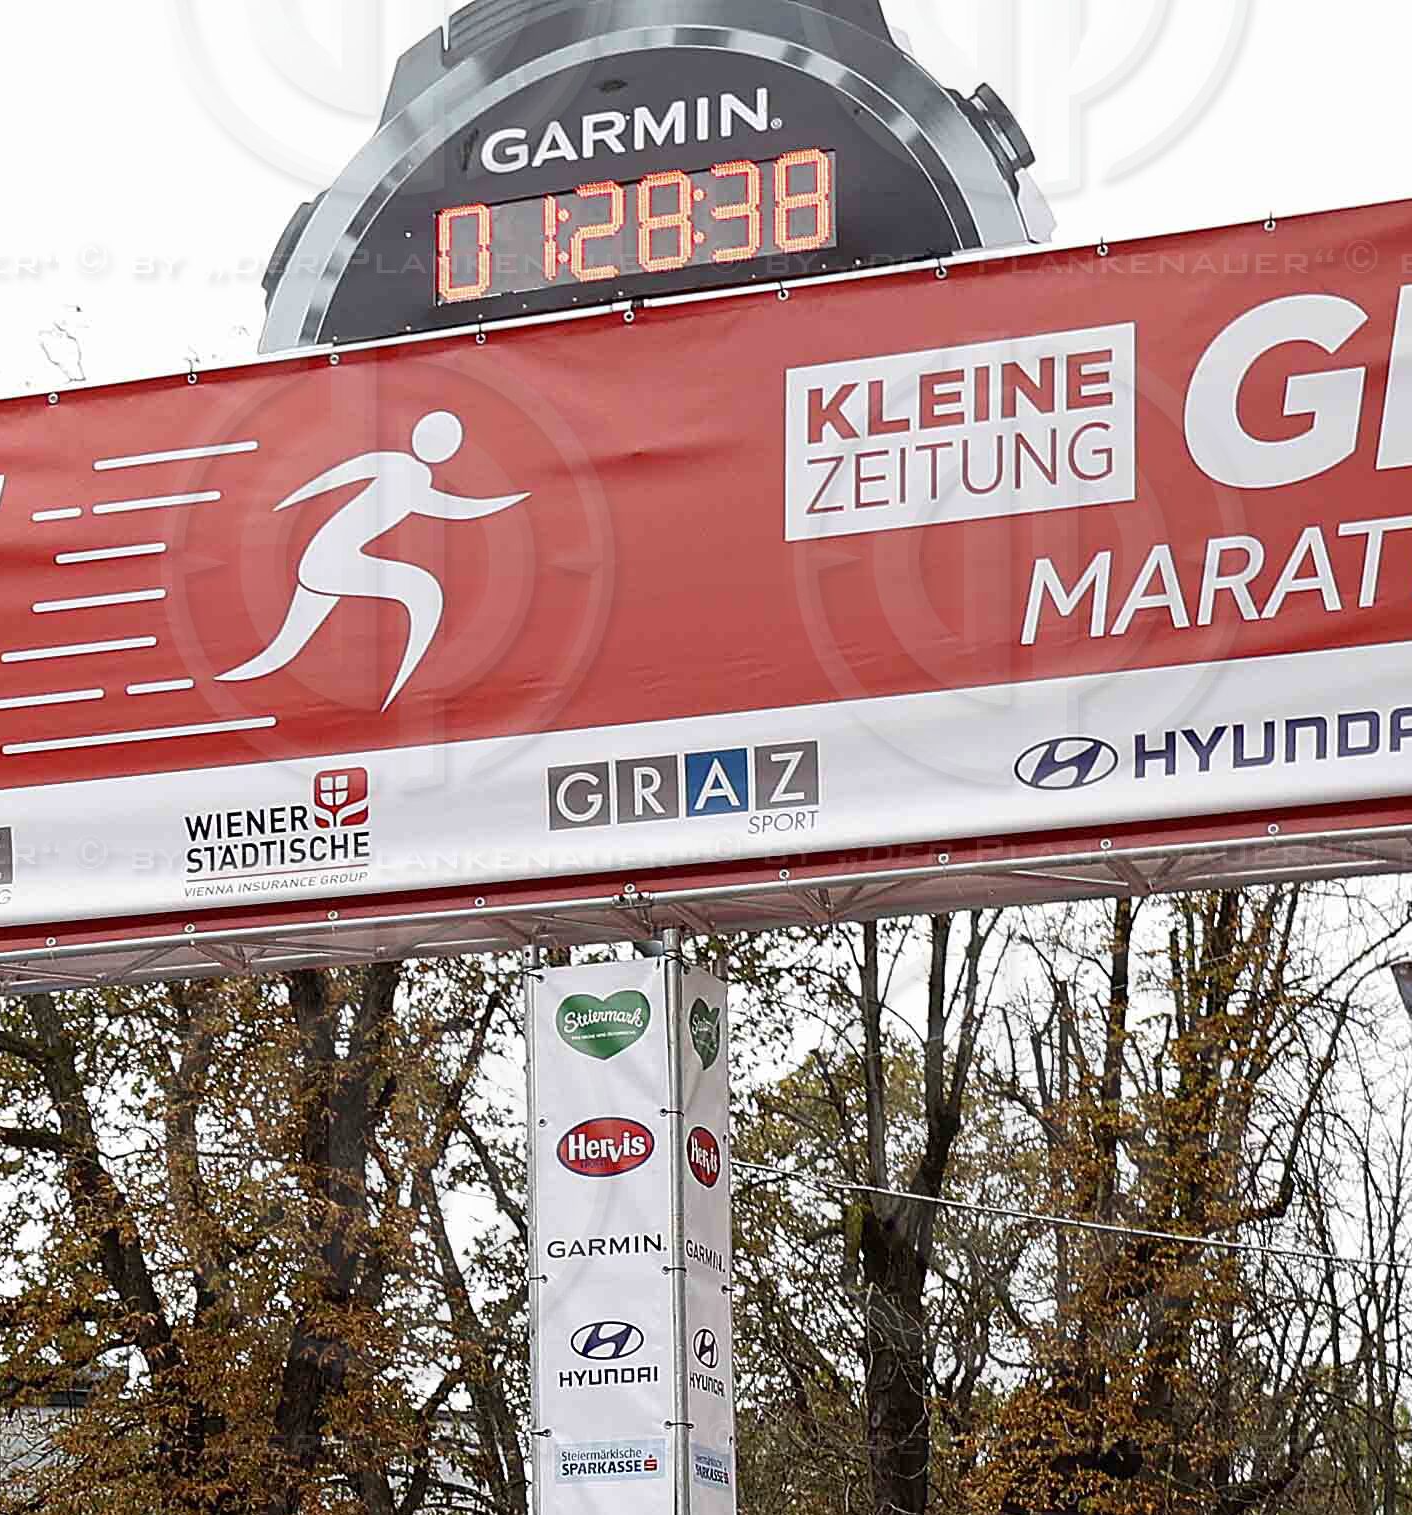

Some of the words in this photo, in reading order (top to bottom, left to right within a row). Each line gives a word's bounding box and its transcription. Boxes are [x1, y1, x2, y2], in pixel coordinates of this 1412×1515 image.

[806, 346, 1116, 444] KLEINE
[806, 419, 1116, 515] ZEITUNG
[556, 748, 814, 822] GRAZ
[184, 804, 309, 842] WIENER
[747, 808, 820, 835] SPORT
[185, 830, 371, 875] STÄDTISCHE
[184, 881, 234, 897] VIENNA
[237, 876, 317, 893] INSURANCE
[319, 871, 368, 888] GROUP
[563, 1002, 644, 1034] Steiermark
[566, 1129, 647, 1163] Hervis
[558, 1365, 659, 1389] HYUNDAI
[561, 1447, 642, 1463] Steiermärkische
[561, 1457, 642, 1476] SPARKASSE
